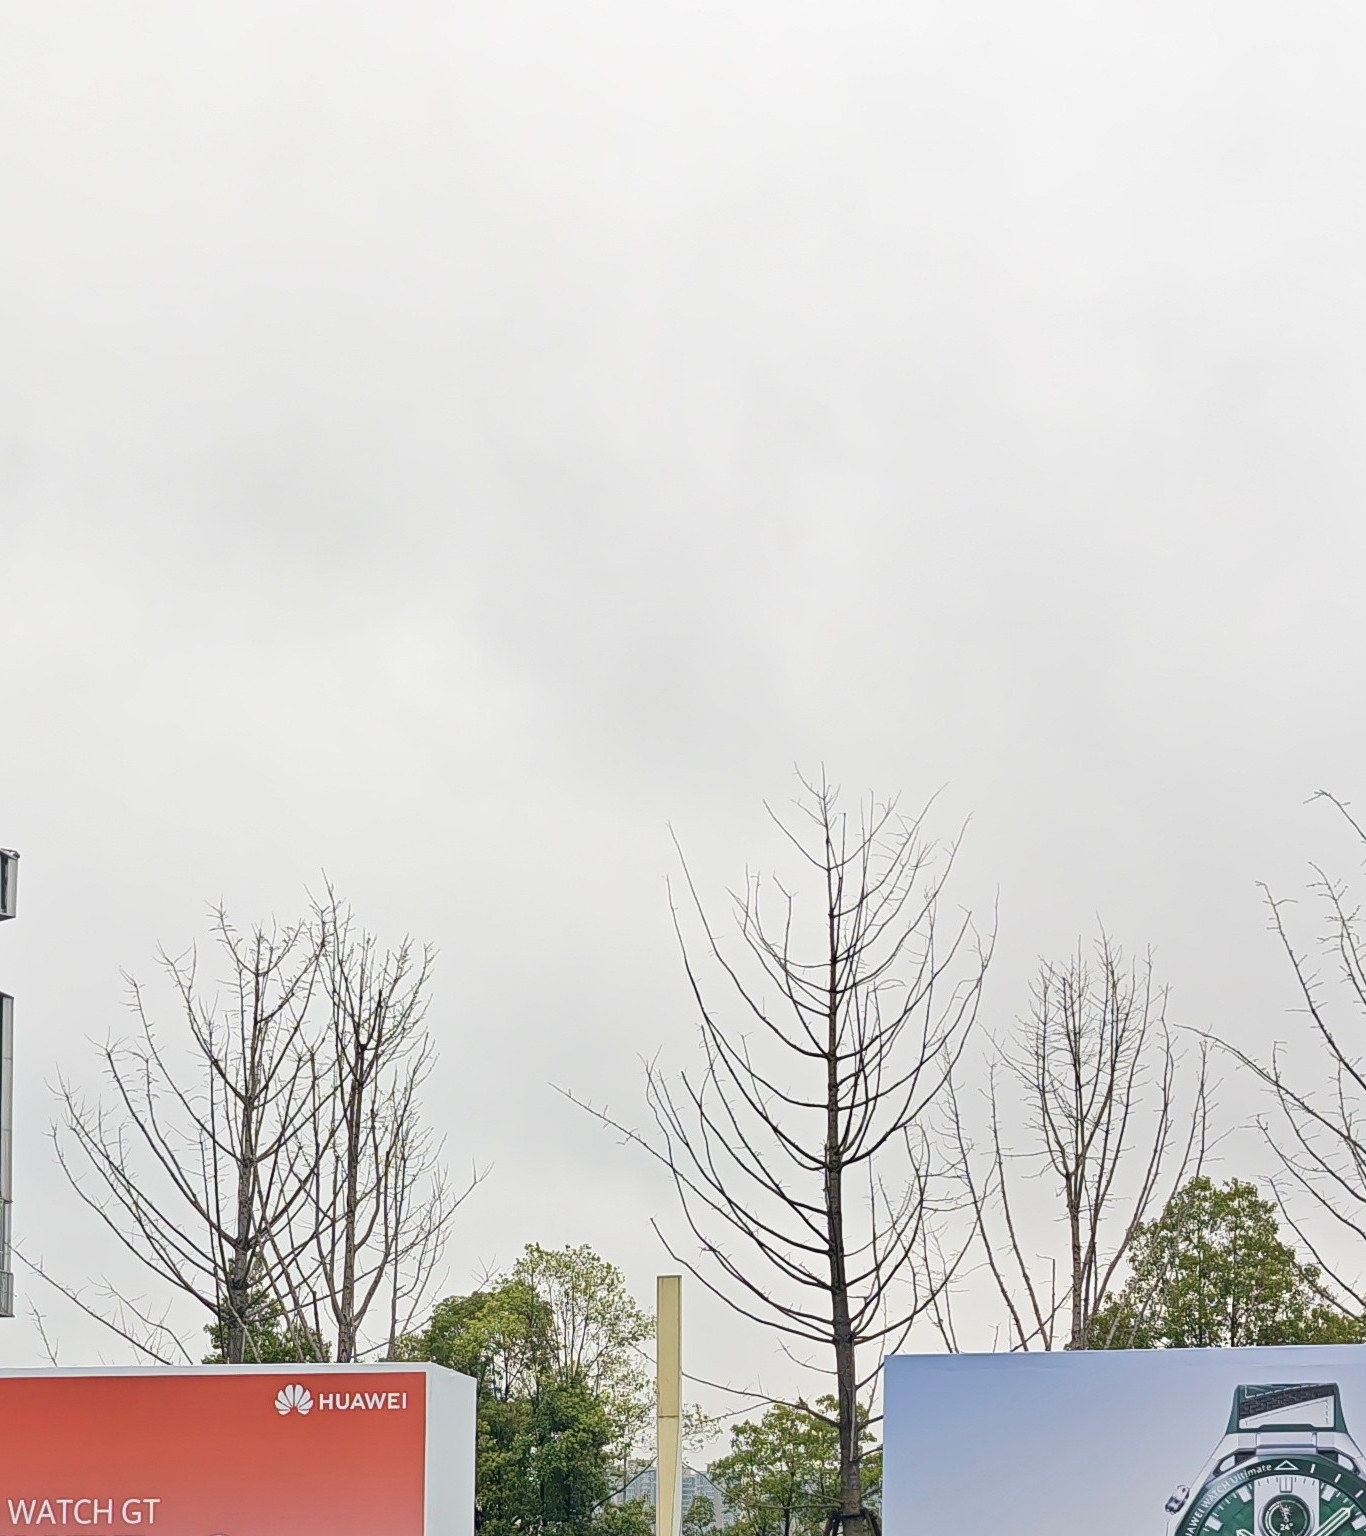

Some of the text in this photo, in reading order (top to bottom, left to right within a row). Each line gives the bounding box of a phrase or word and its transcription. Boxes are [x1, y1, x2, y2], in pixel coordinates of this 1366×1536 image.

[319, 1391, 407, 1411] HUAWEI
[8, 1499, 113, 1526] WATCH
[121, 1498, 161, 1525] GT
